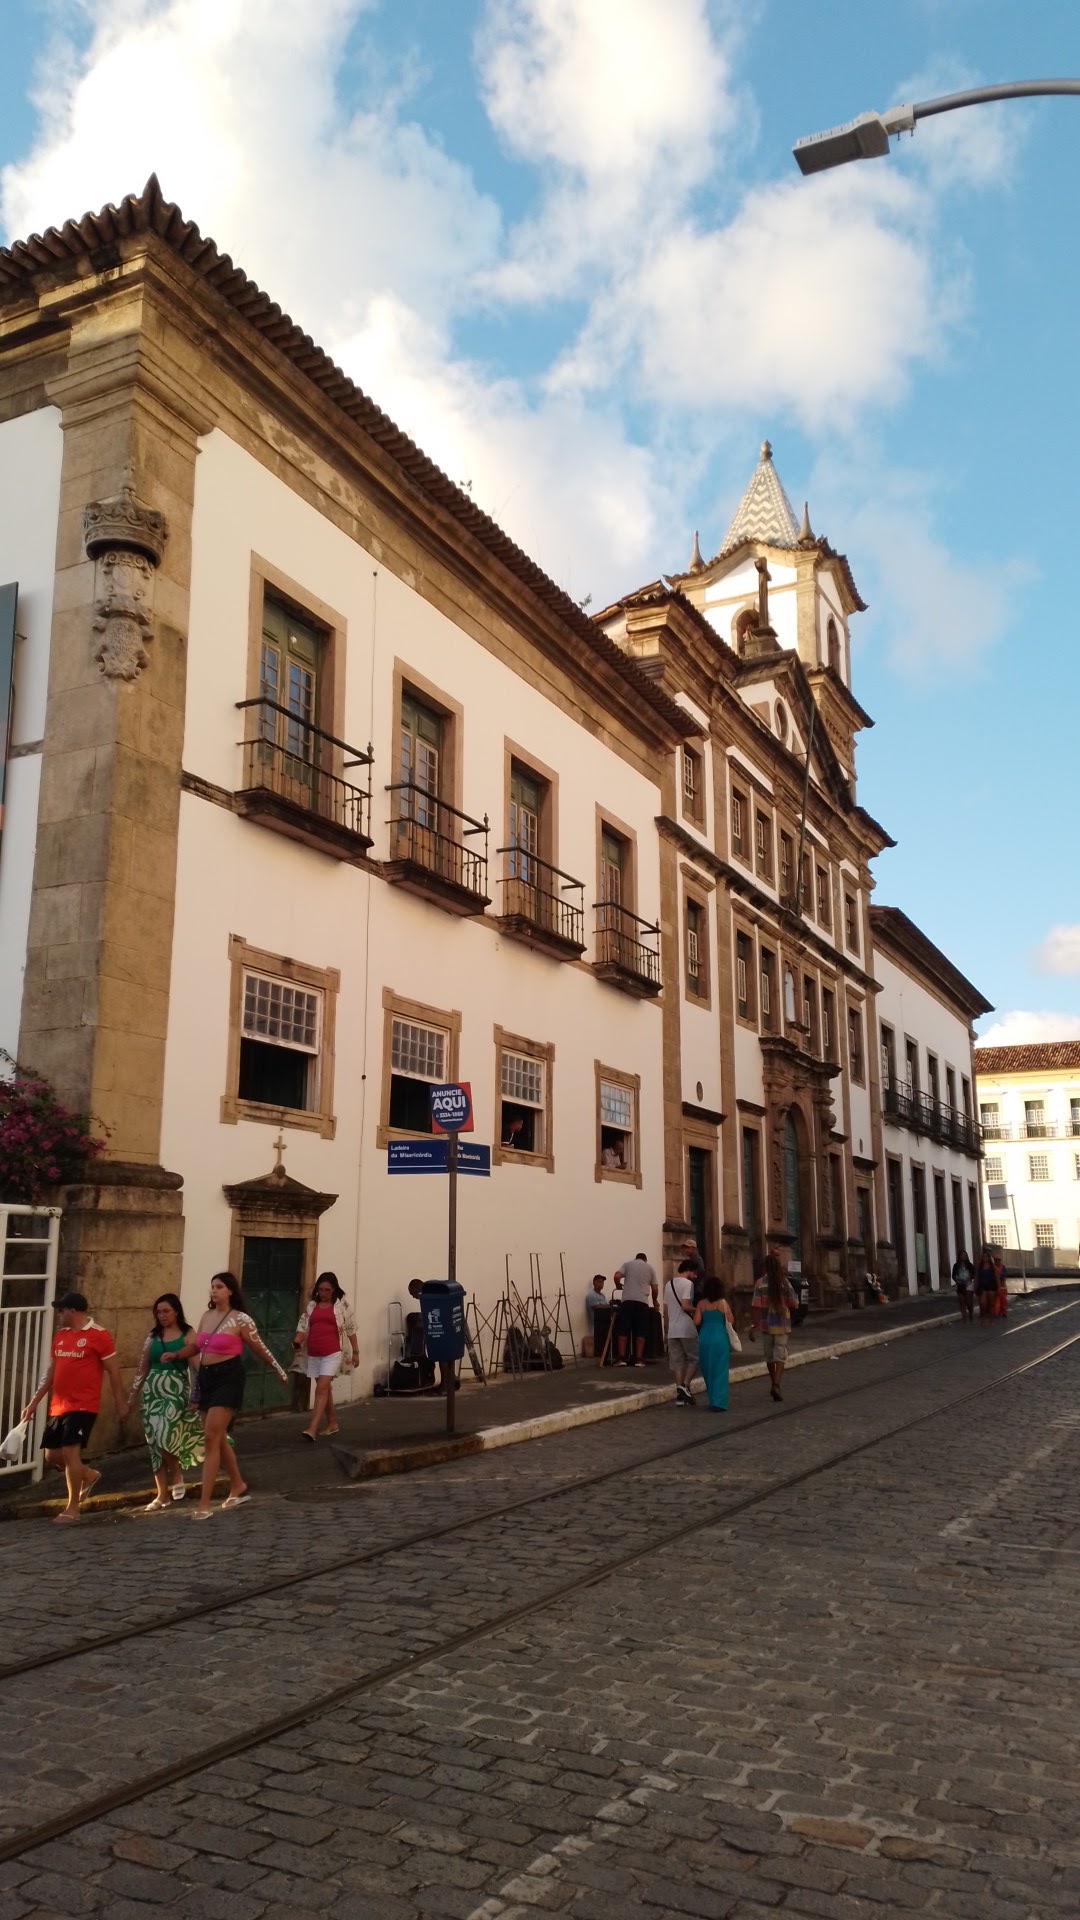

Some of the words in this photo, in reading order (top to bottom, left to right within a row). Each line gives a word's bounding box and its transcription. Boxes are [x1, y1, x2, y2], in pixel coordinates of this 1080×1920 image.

[432, 1089, 462, 1097] ANUNCIE
[433, 1096, 466, 1111] AQUI
[57, 1349, 84, 1358] Banrisul
